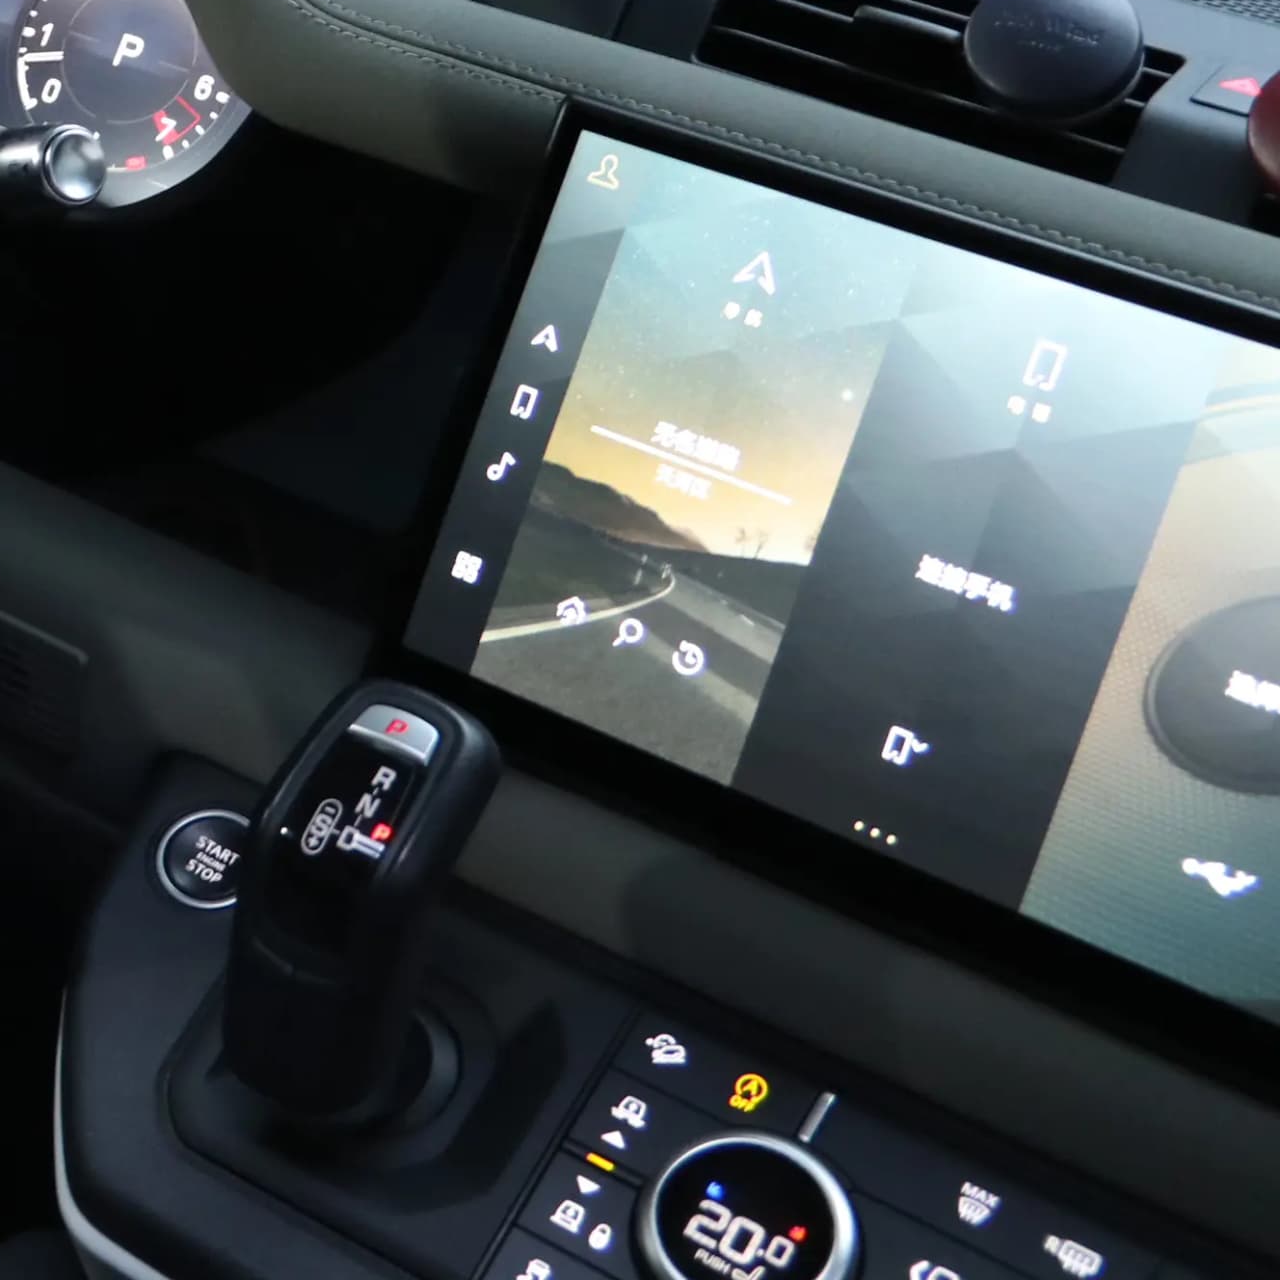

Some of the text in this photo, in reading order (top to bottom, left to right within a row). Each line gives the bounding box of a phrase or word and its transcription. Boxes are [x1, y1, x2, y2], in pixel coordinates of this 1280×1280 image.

[40, 22, 54, 47] 1
[112, 32, 145, 67] P
[40, 77, 62, 104] 0
[193, 74, 215, 101] 6
[154, 116, 177, 142] 7
[385, 718, 410, 735] P
[371, 765, 397, 791] R
[354, 792, 381, 818] N
[371, 822, 393, 841] P
[195, 835, 241, 866] START
[185, 858, 223, 883] STOP
[961, 1181, 1000, 1209] MAX
[682, 1199, 796, 1268] 20.0
[694, 1247, 733, 1276] PUSH
